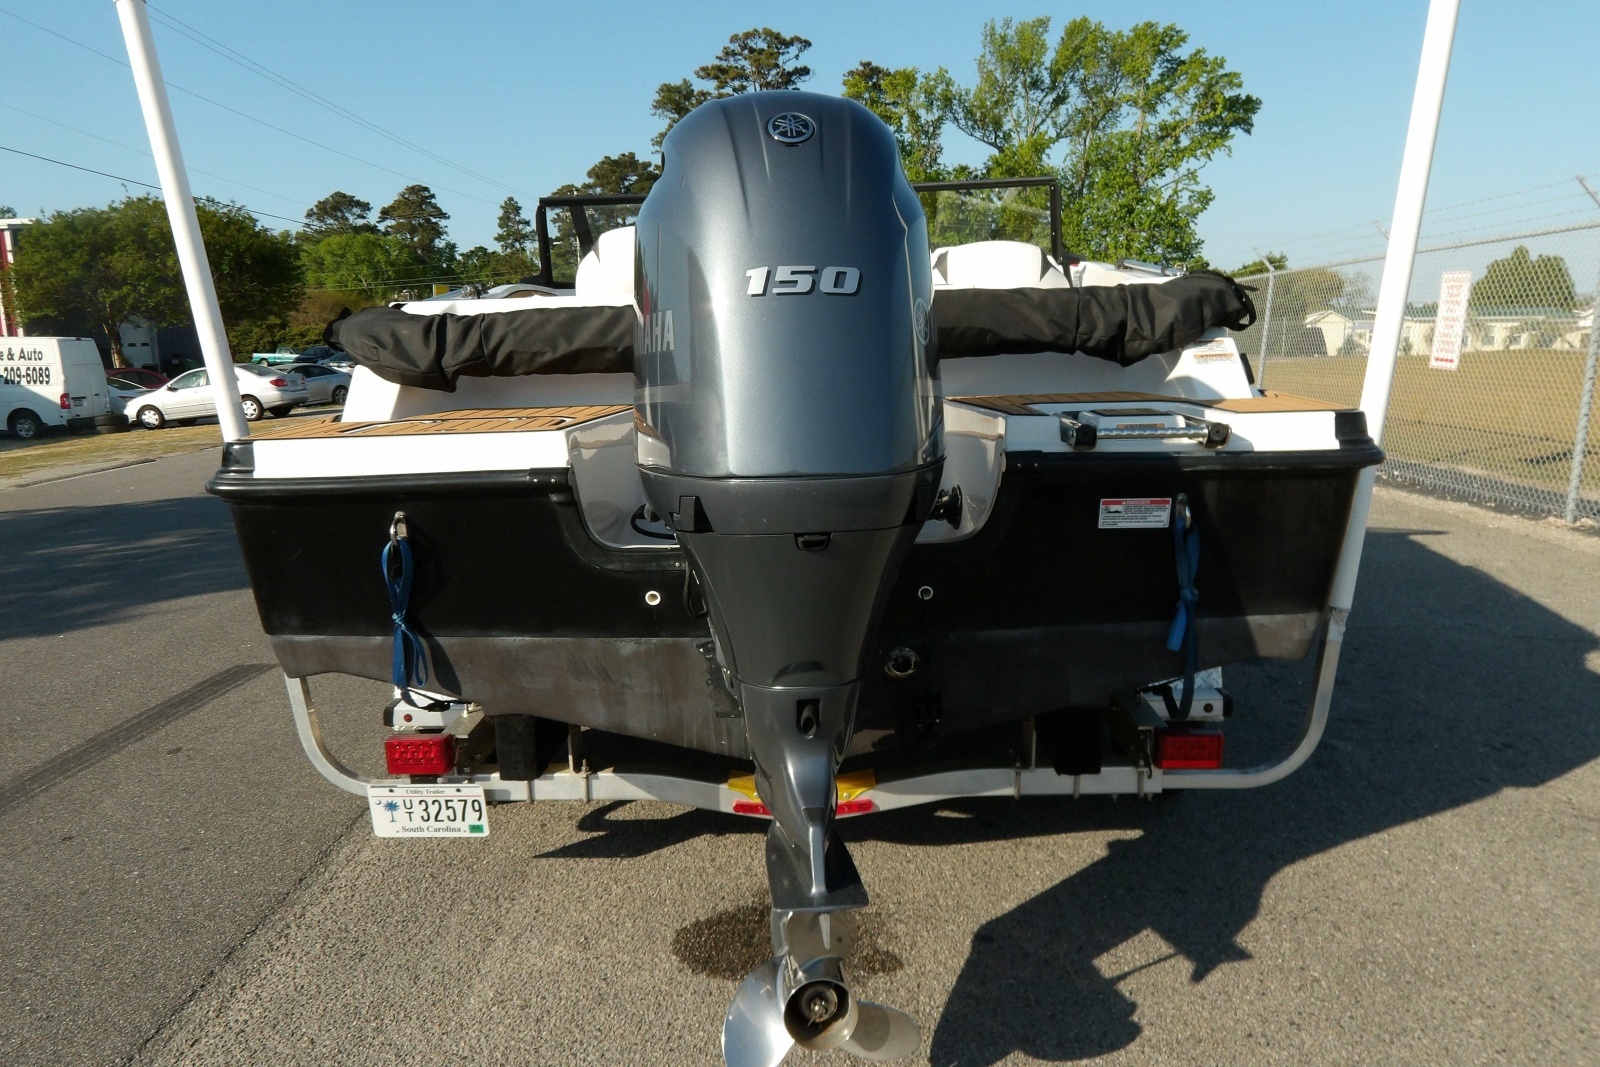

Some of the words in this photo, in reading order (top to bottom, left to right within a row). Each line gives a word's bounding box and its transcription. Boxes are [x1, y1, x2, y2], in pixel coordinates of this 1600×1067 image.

[745, 265, 861, 297] 150
[7, 347, 15, 361] &
[18, 347, 43, 361] Auto
[418, 799, 483, 822] 32579
[401, 825, 424, 833] South
[427, 825, 461, 833] Carolina
